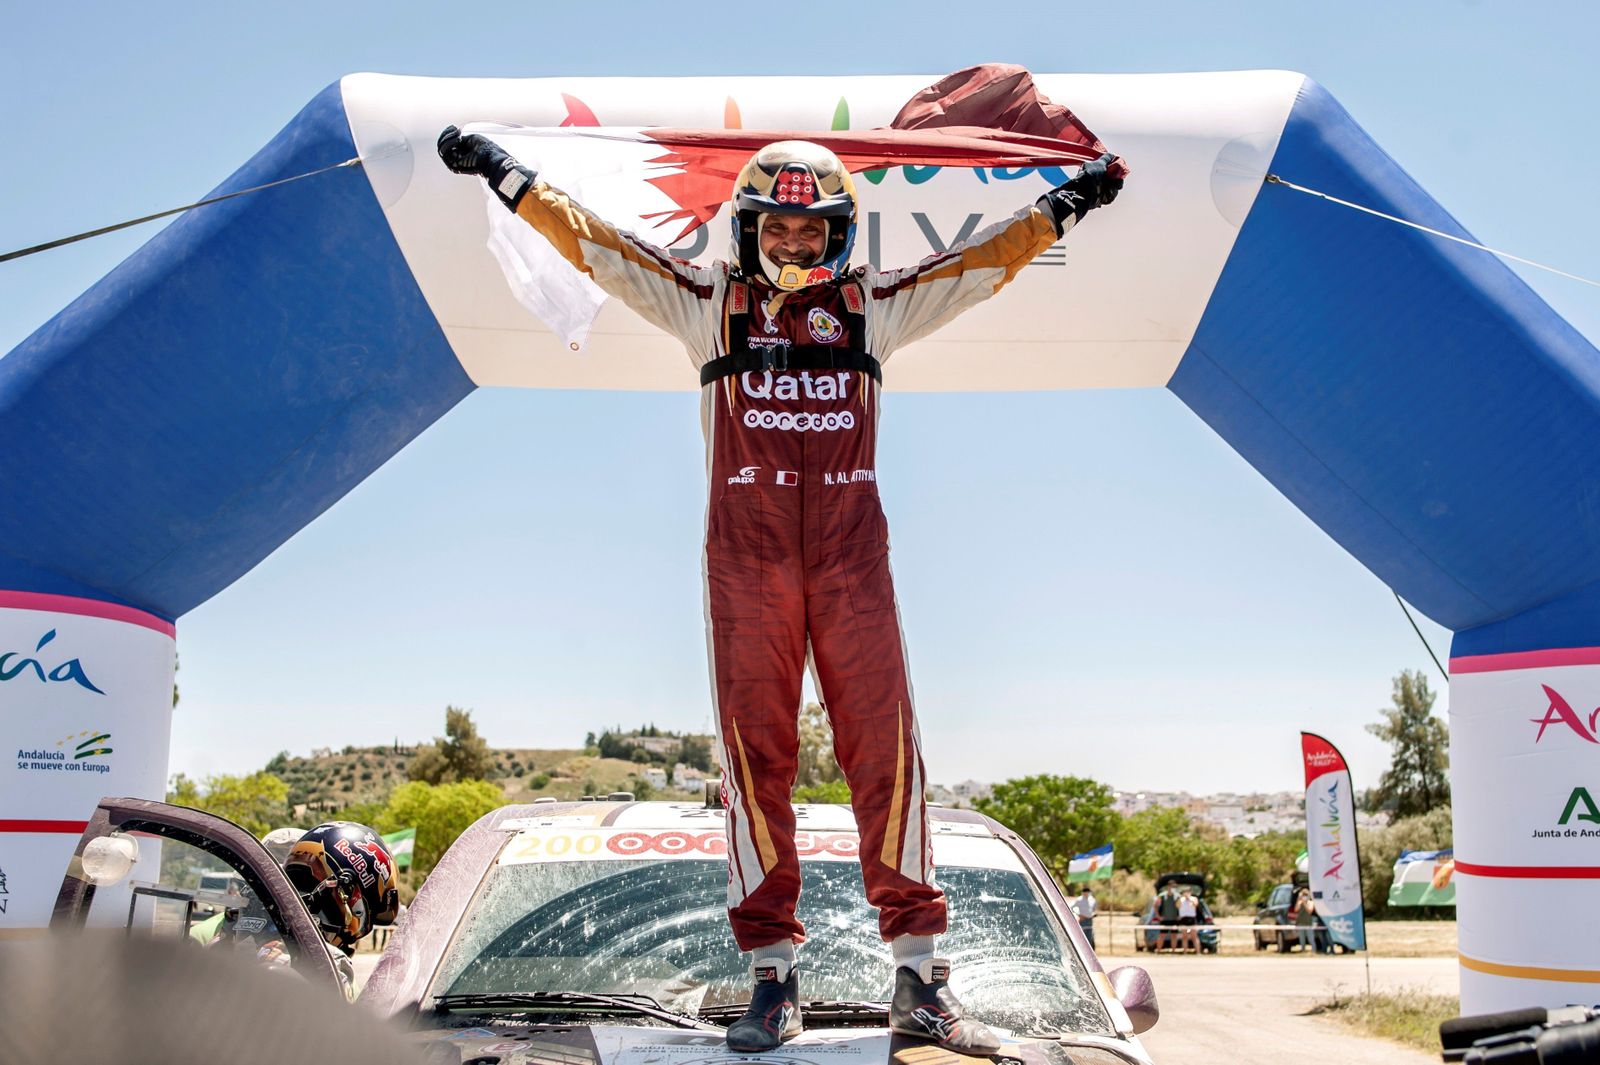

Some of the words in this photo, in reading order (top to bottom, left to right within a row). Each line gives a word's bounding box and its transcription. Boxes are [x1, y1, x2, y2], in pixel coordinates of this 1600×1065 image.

[742, 370, 851, 400] Qatar
[744, 409, 855, 432] ooredoo
[825, 472, 835, 485] N.
[837, 471, 849, 484] AL
[17, 749, 65, 760] Andalucía
[17, 762, 29, 770] se
[31, 762, 63, 770] mueve
[65, 762, 80, 771] con
[82, 762, 110, 774] Europa
[1532, 829, 1561, 838] Junta
[1564, 829, 1578, 838] de
[514, 834, 602, 858] 200
